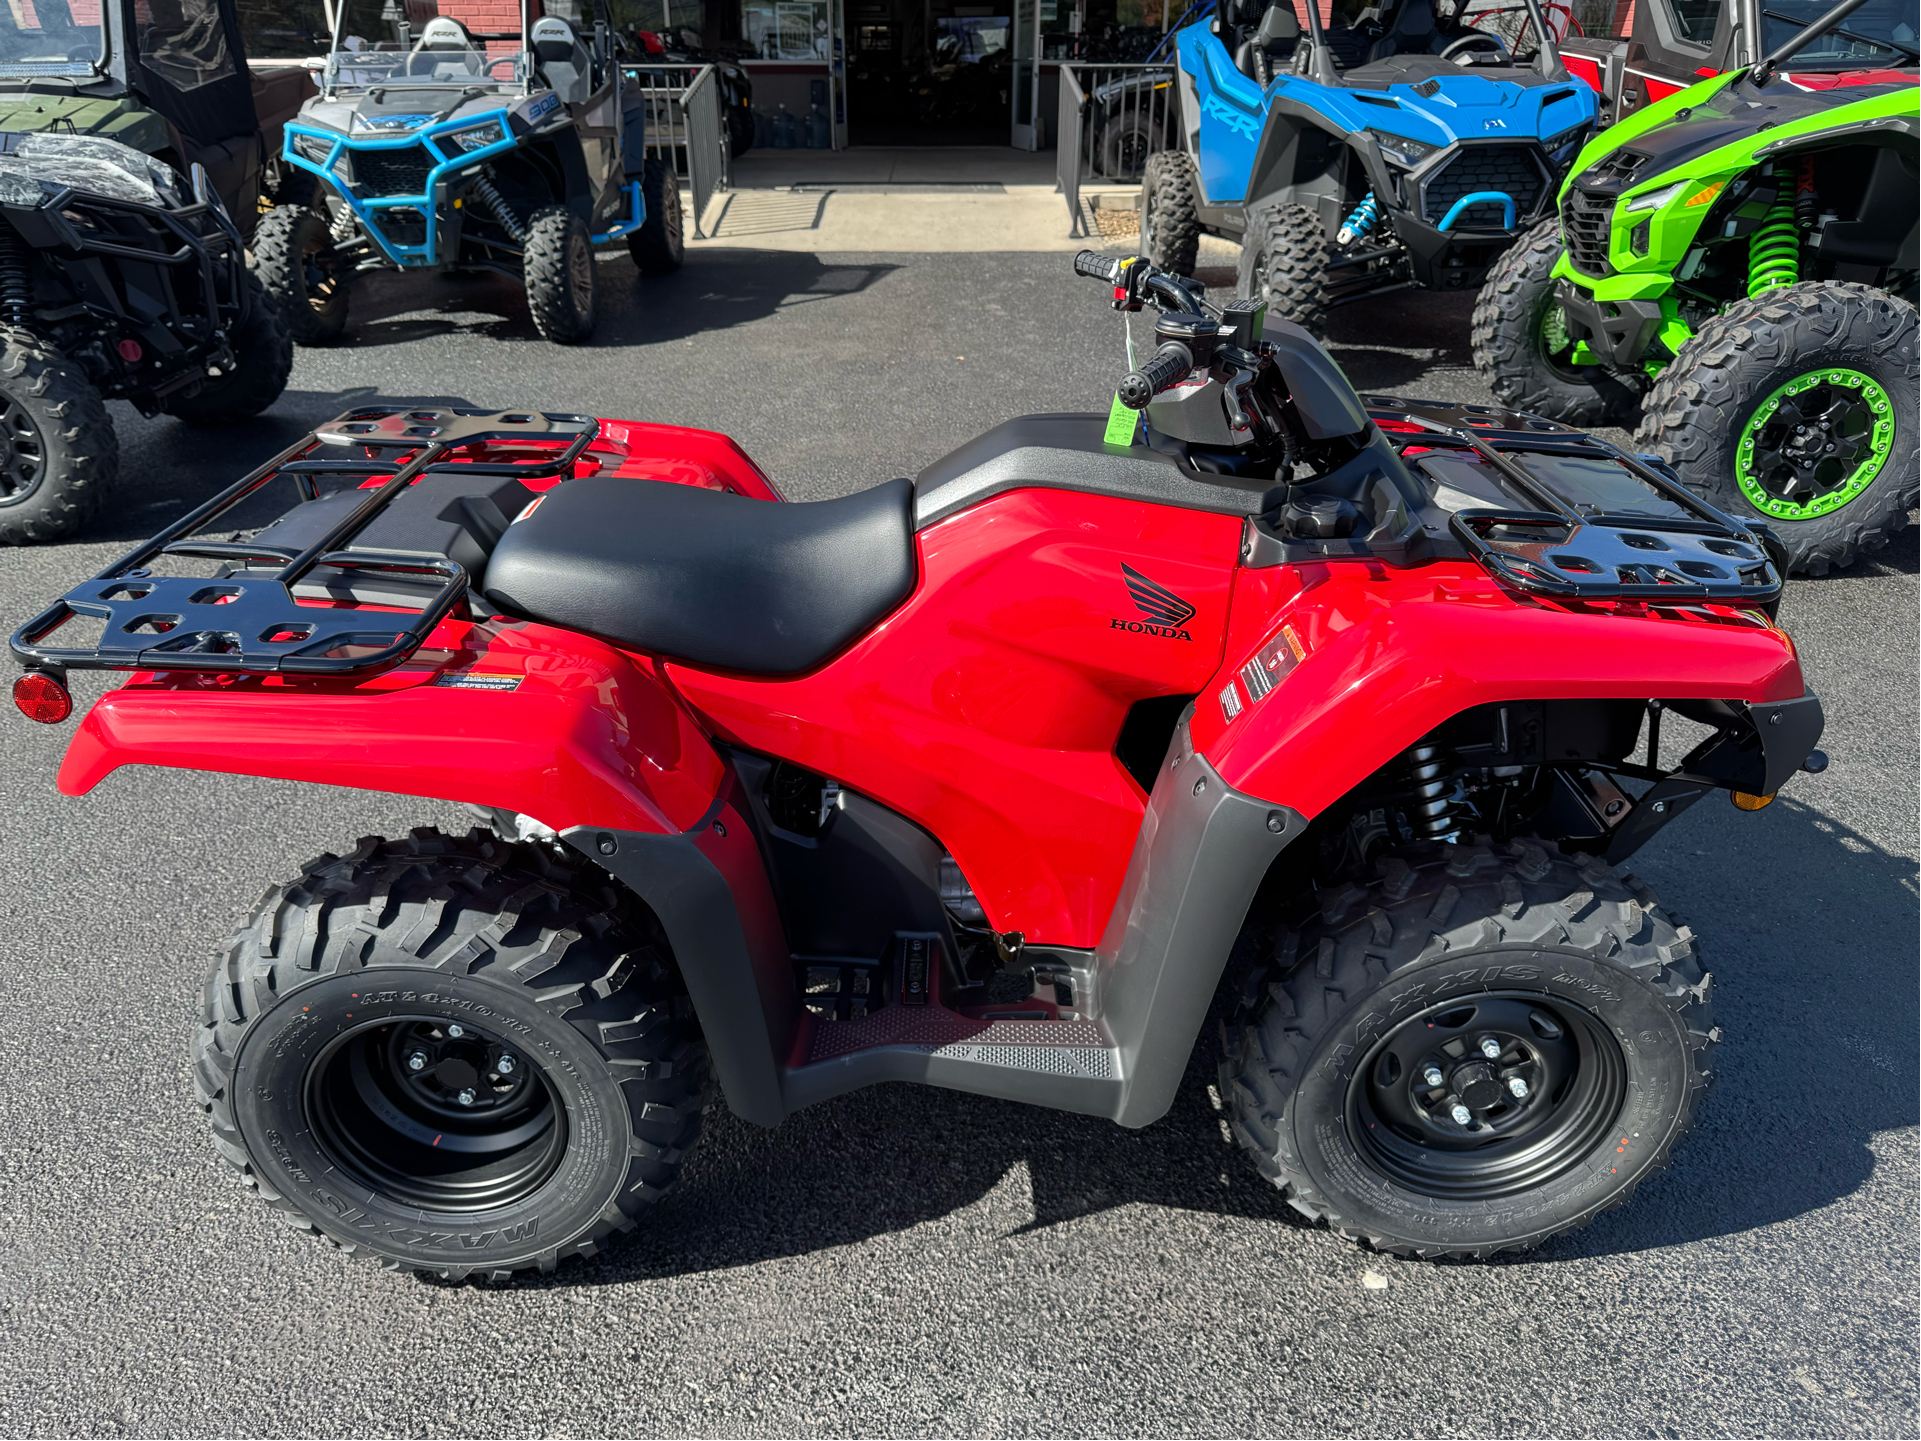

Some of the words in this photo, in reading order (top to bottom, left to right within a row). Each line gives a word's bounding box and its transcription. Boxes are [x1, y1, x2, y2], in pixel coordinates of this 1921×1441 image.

[431, 30, 457, 38] RZR
[1202, 93, 1260, 142] RZR
[1110, 618, 1193, 641] HONDA
[1324, 964, 1545, 1080] MAXXIS
[309, 1187, 540, 1249] MAXXIS
